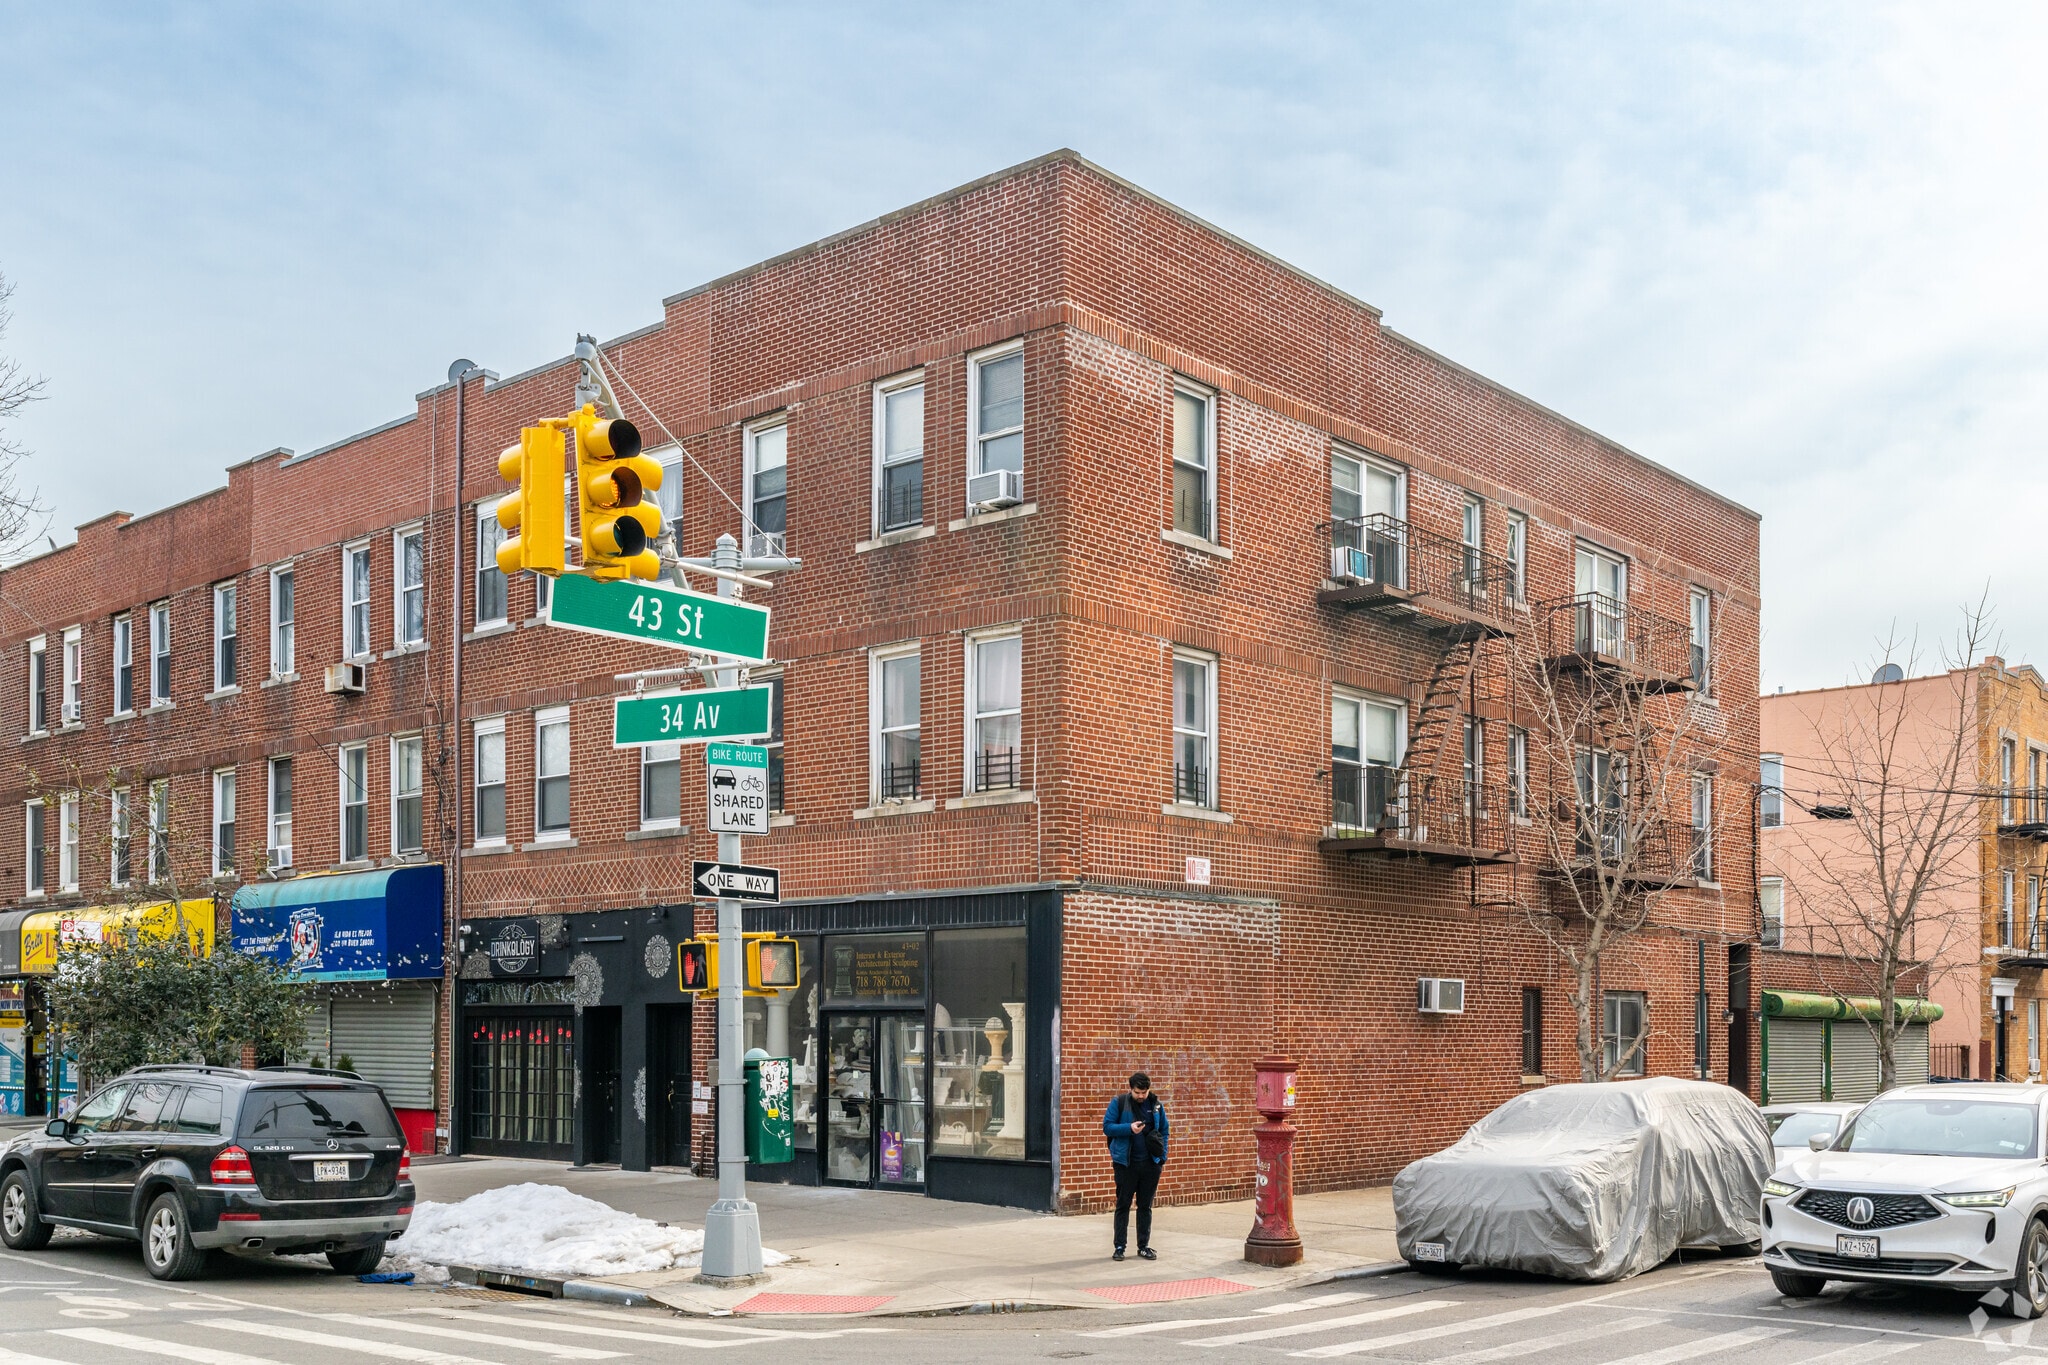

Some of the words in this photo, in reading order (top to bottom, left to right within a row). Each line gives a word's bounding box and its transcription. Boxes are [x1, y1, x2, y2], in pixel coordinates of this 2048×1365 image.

[628, 595, 663, 631] 43
[676, 604, 704, 639] St
[660, 704, 684, 733] 34
[693, 701, 720, 730] Av
[712, 749, 731, 761] BIKE
[736, 750, 763, 763] ROUTE
[714, 793, 764, 810] SHARED
[723, 812, 756, 827] LANE
[1187, 859, 1196, 881] NO
[708, 873, 734, 888] ONE
[745, 876, 769, 891] WAY
[856, 959, 891, 968] Architectural
[892, 959, 919, 968] Sculpting
[857, 952, 875, 960] Interior
[877, 951, 882, 959] &
[883, 951, 906, 959] Exterior
[856, 976, 869, 987] 718
[872, 976, 887, 987] 786
[891, 975, 910, 986] 7670
